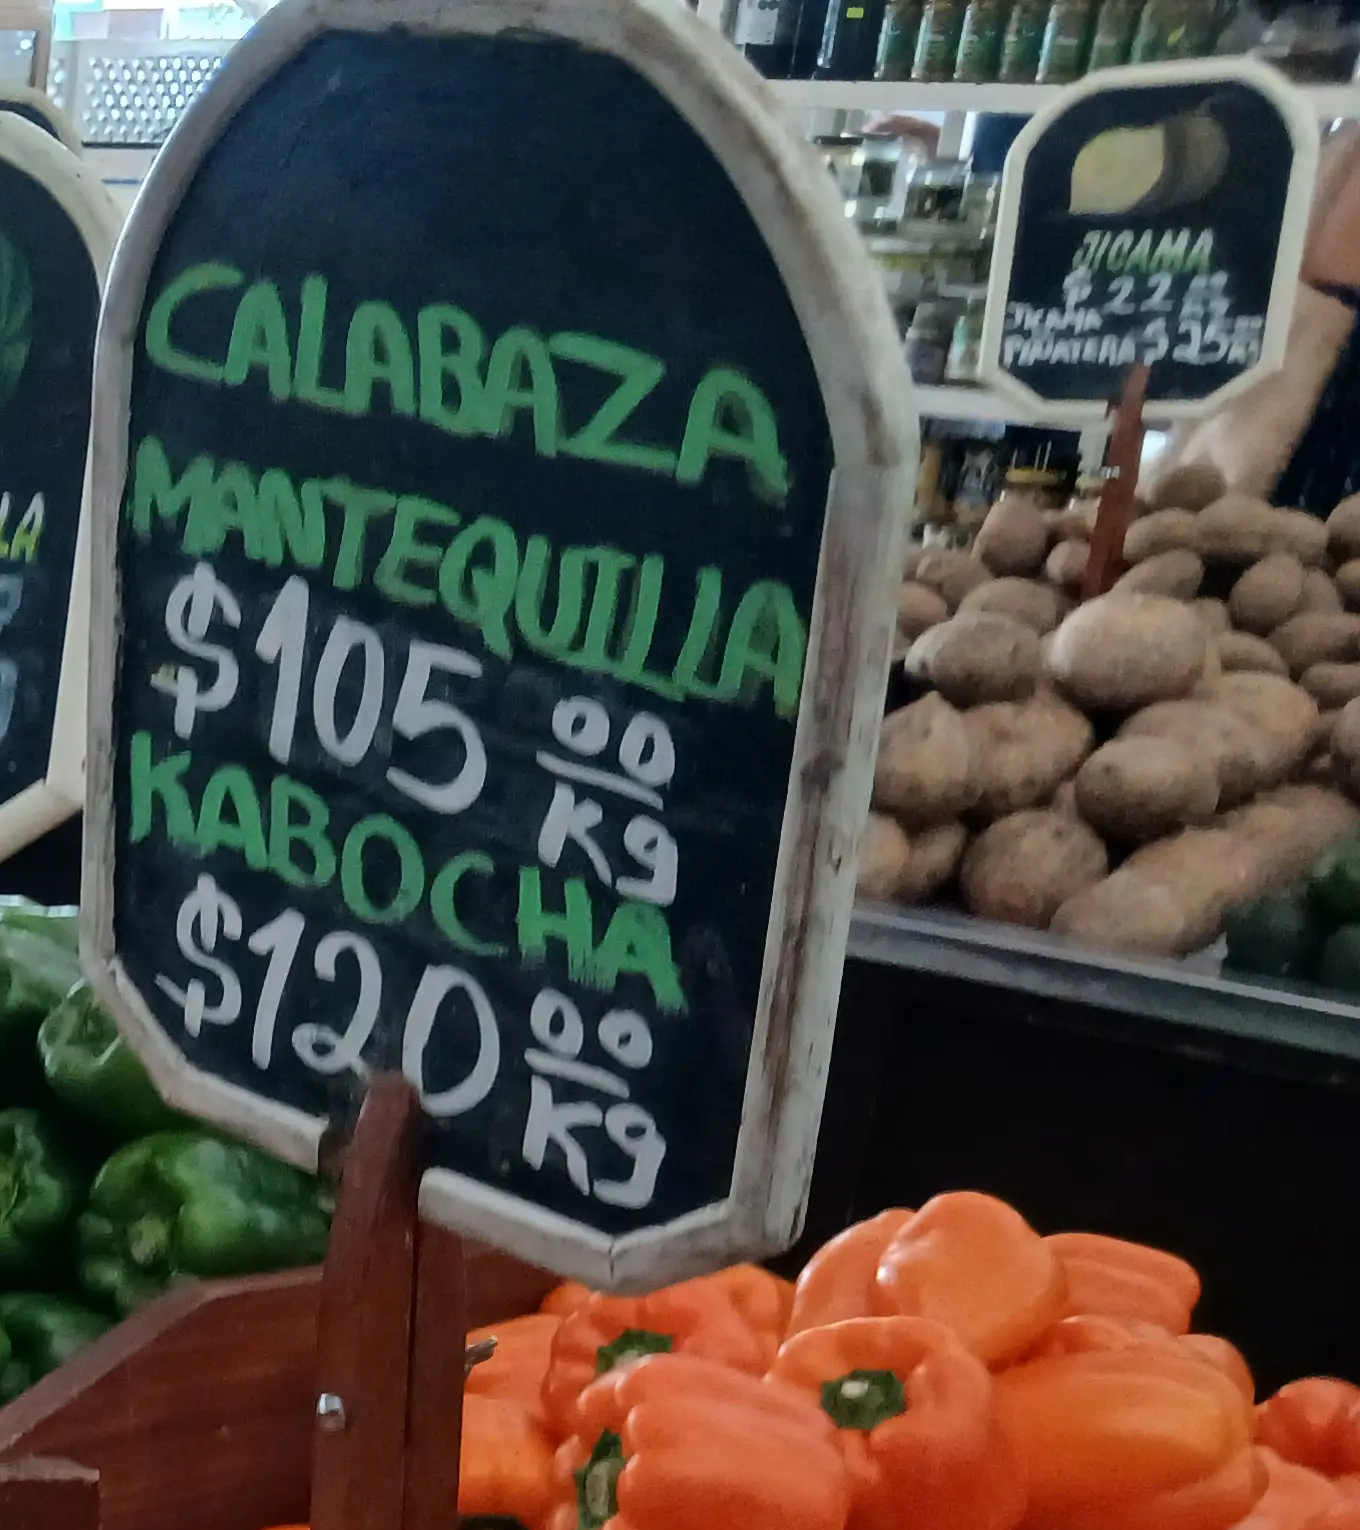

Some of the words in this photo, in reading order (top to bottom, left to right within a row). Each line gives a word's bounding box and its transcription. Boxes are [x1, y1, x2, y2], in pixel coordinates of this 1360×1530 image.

[1072, 228, 1214, 275] JICAMA
[144, 262, 791, 508] CALABAZA
[128, 435, 808, 720] MANTEQUILLA
[150, 562, 488, 814] $105
[130, 730, 689, 1015] KABOCHA
[154, 873, 501, 1118] $120
